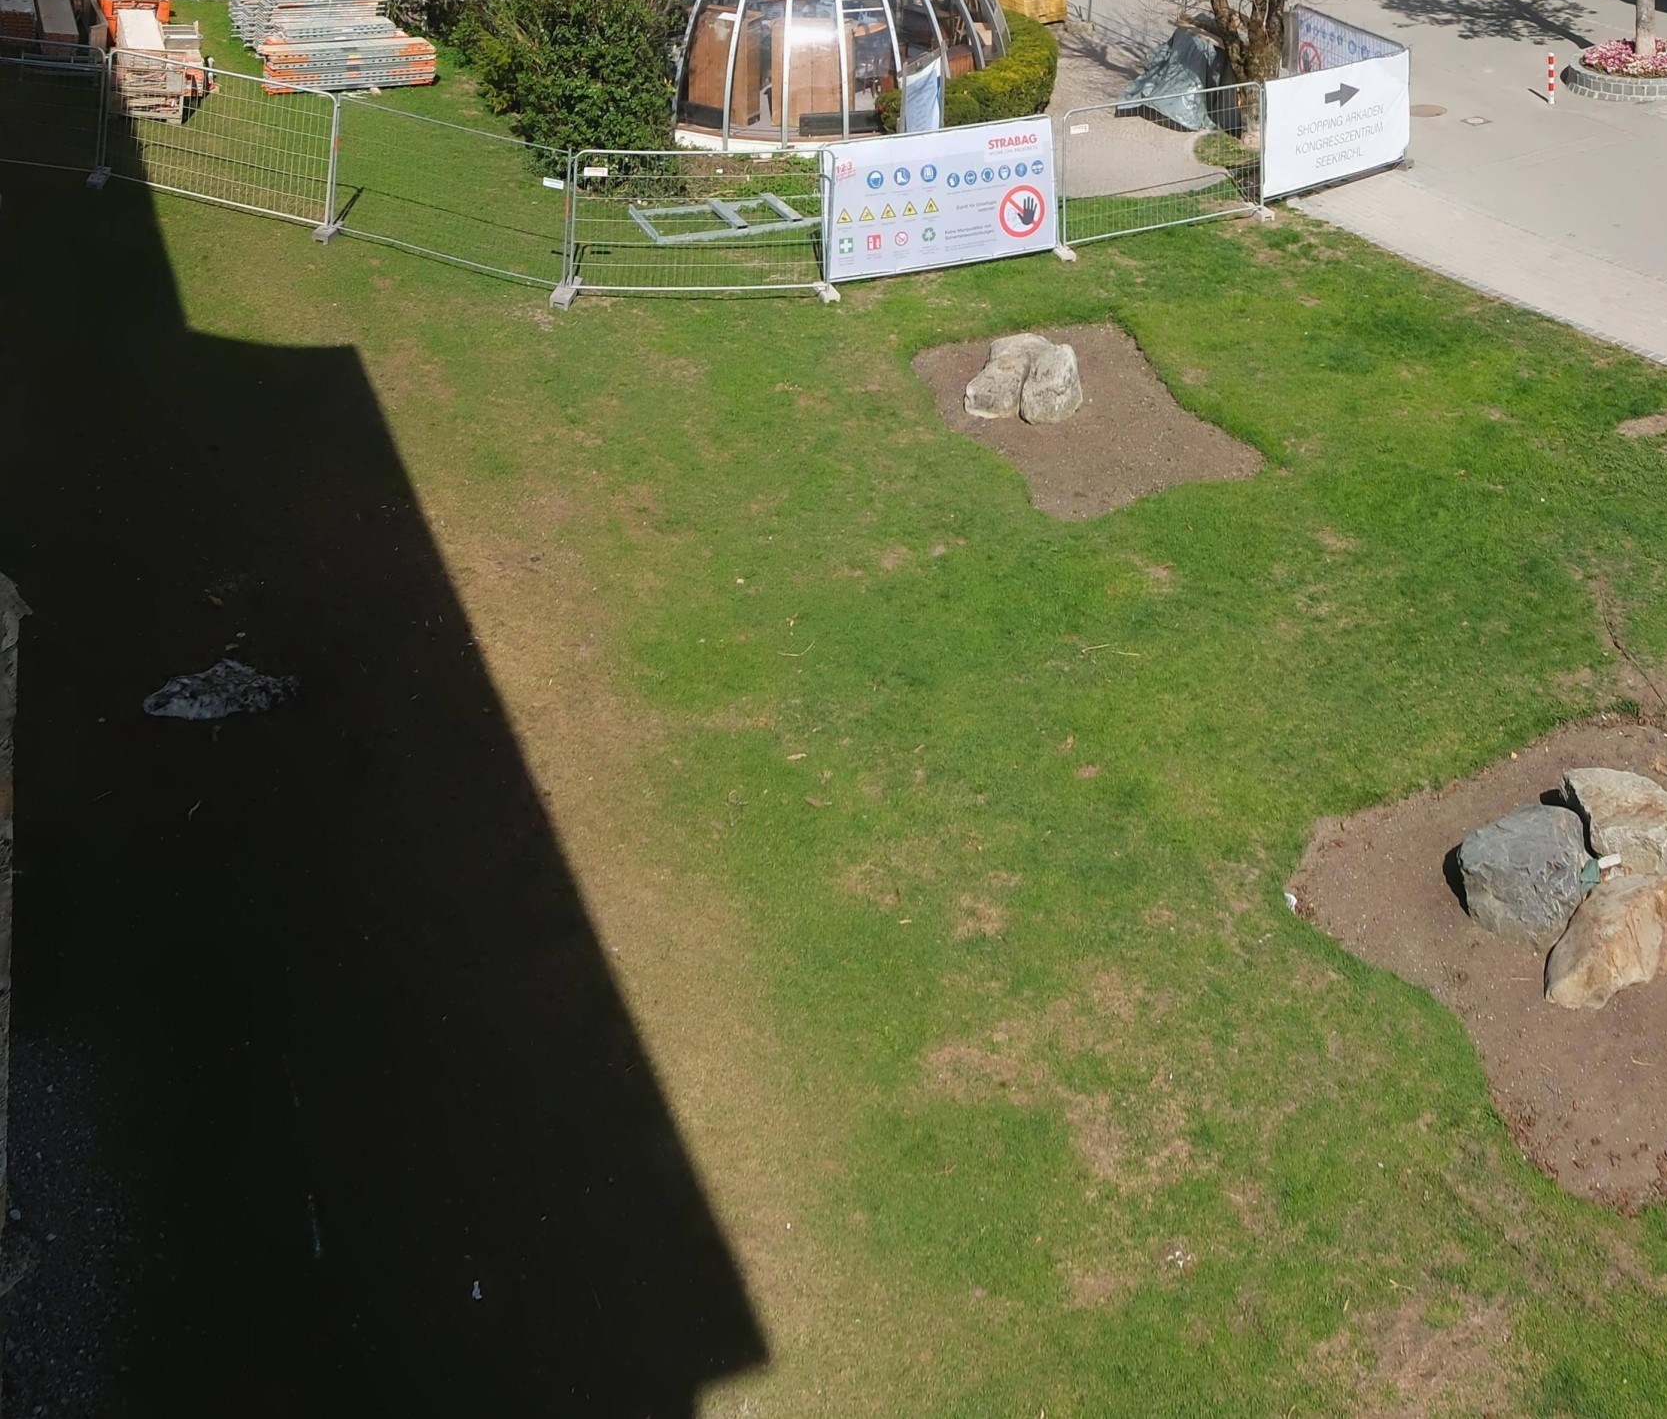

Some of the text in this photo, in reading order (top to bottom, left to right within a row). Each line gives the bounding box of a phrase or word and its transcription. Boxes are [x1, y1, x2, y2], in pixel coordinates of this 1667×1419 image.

[1297, 103, 1384, 137] SHOPPING ARKADEN
[988, 133, 1038, 150] STRABAG
[1295, 122, 1384, 156] KONGRESSZENTRUM
[1315, 149, 1363, 168] SEEKIRCHL
